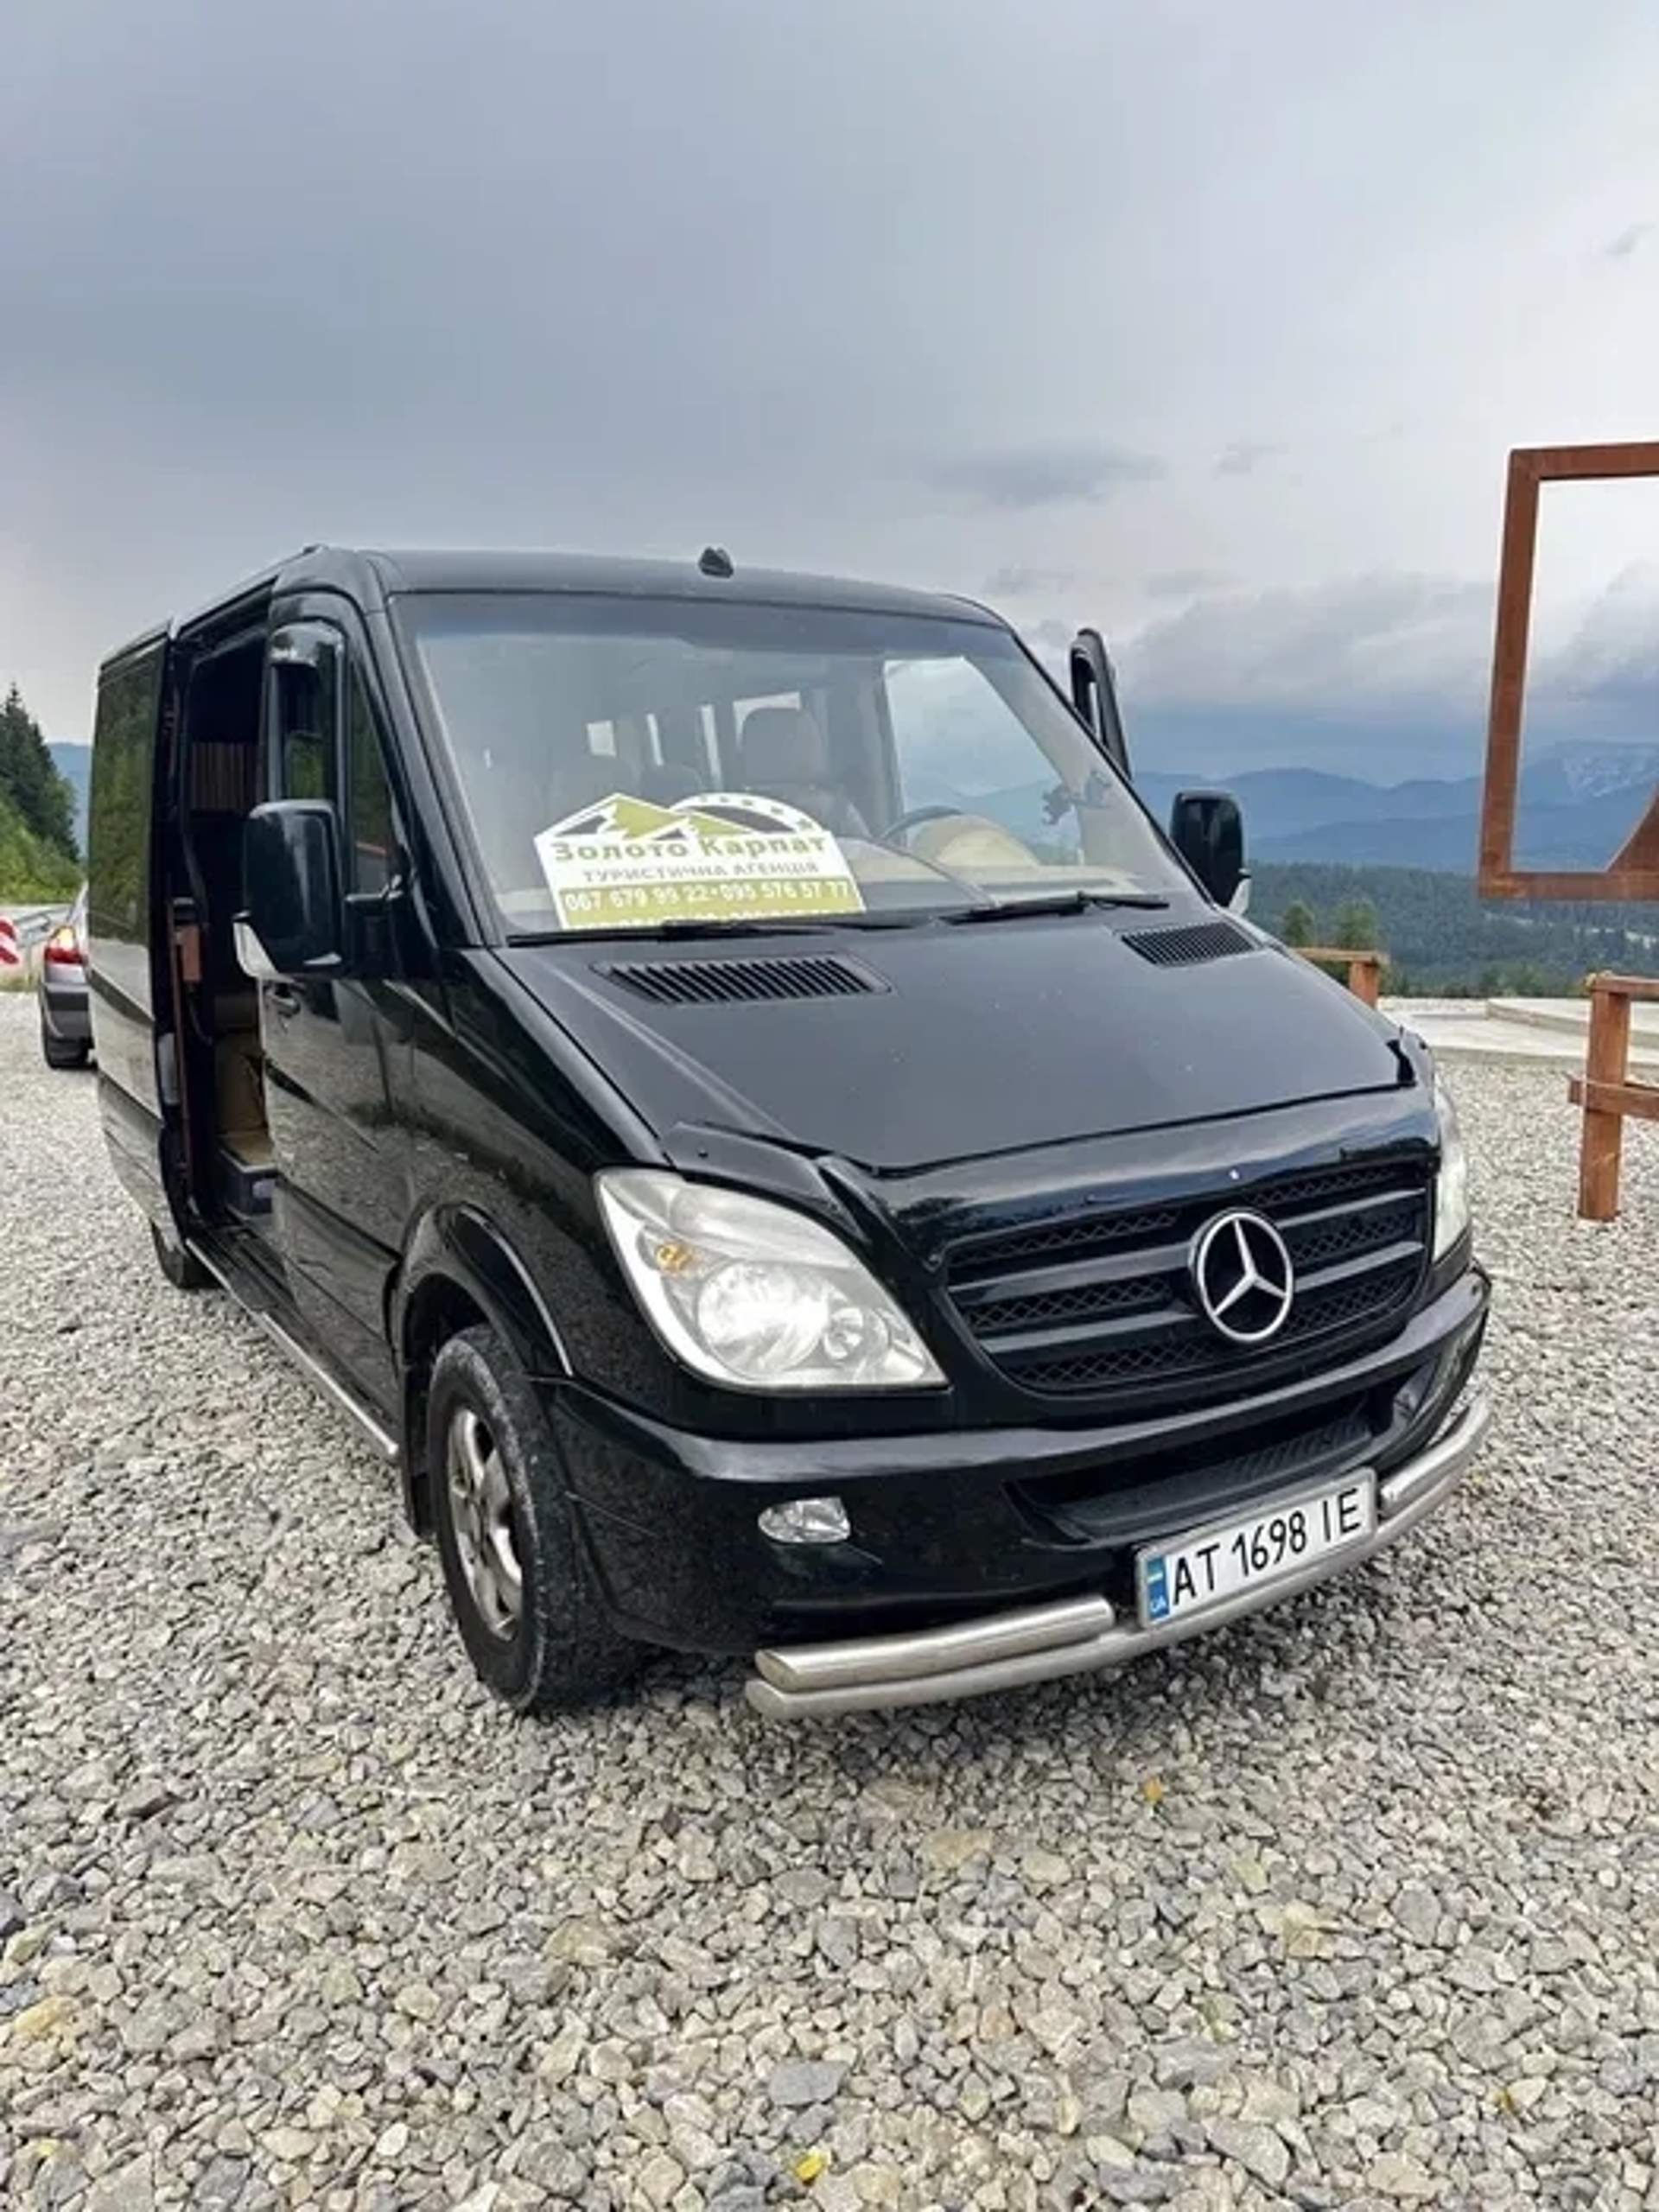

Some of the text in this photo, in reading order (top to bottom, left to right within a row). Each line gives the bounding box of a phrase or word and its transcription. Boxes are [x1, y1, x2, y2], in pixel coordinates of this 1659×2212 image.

[551, 836, 826, 861] Золото Карпат
[583, 865, 728, 882] ТУРИСТИЧНА
[564, 890, 602, 911] 067
[825, 880, 849, 898] 77
[1173, 1543, 1221, 1605] AT
[1230, 1510, 1306, 1577] 1698
[1322, 1487, 1362, 1542] IE
